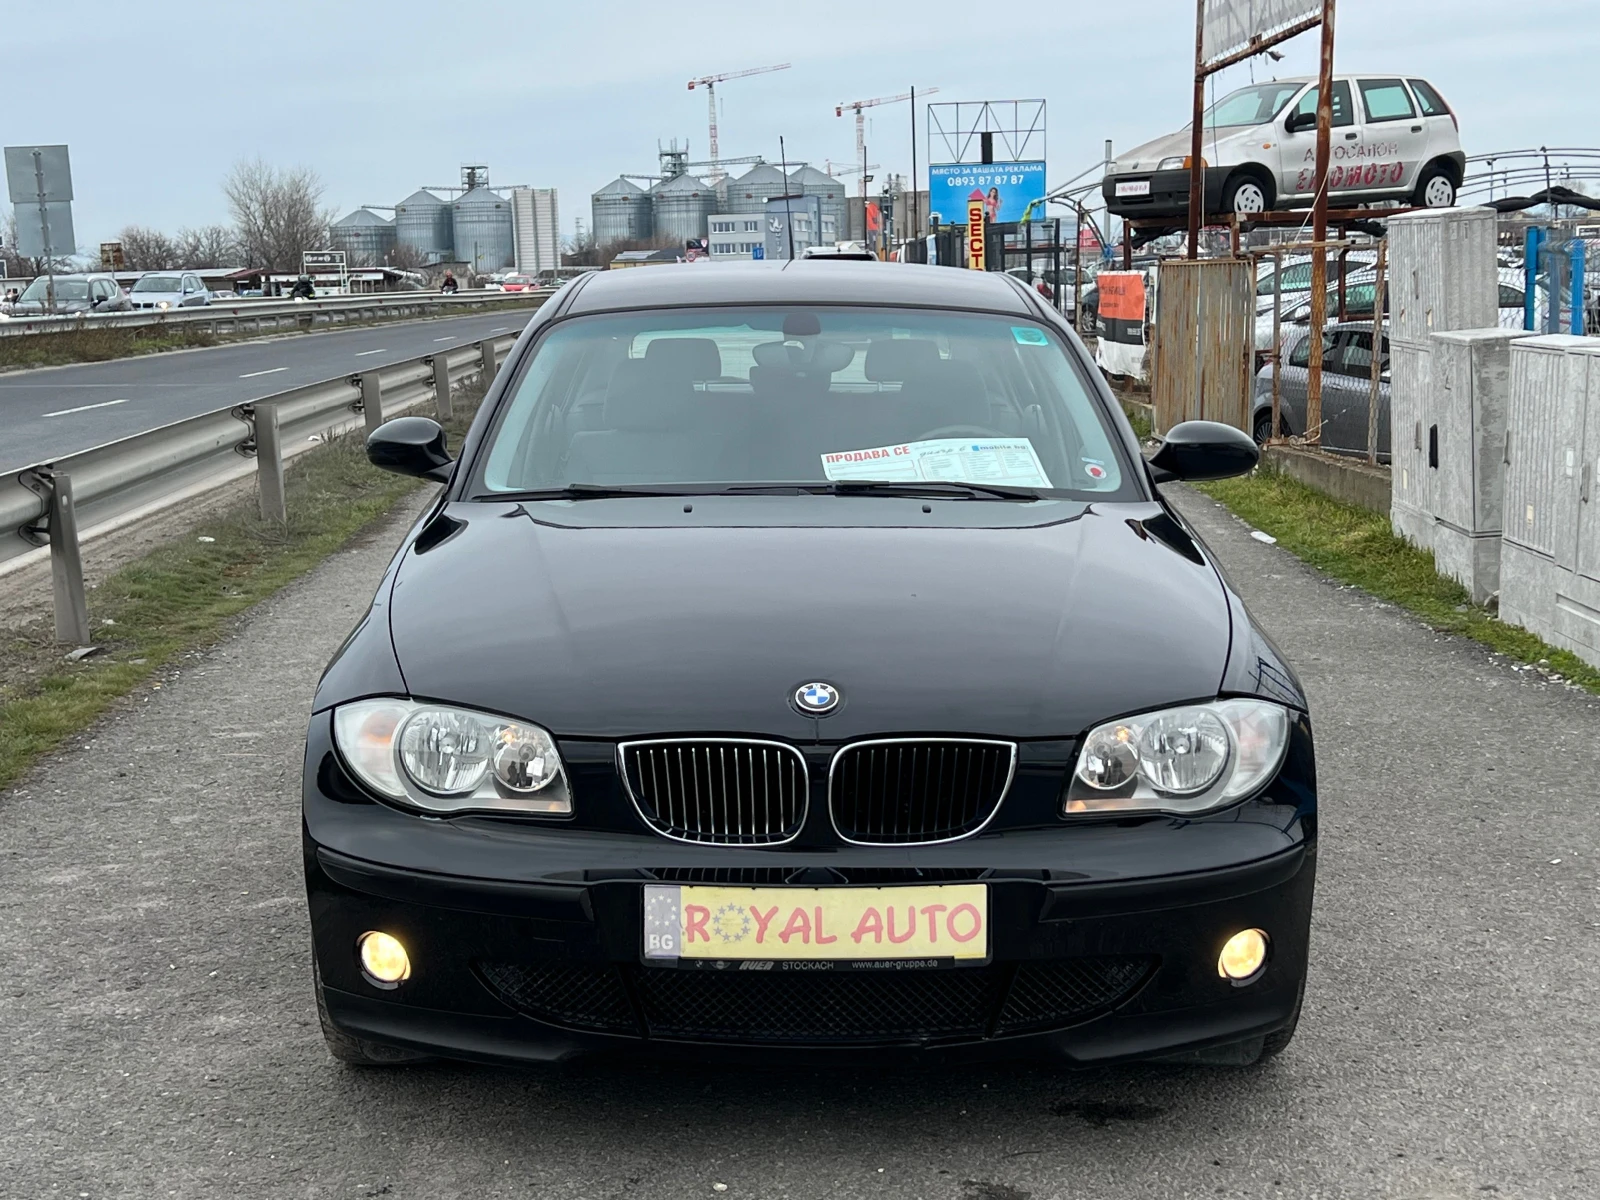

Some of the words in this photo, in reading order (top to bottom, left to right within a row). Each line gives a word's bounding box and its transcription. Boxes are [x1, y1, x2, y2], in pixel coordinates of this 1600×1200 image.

[1303, 143, 1398, 162] АОСАЛОН
[973, 166, 1003, 174] ВАШАТА
[1005, 165, 1042, 173] РЕКЛАМА
[947, 176, 976, 187] 0893
[978, 175, 991, 186] 87
[994, 175, 1008, 185] 87
[1010, 175, 1024, 185] 87
[969, 208, 983, 271] SECT
[825, 448, 890, 463] ПРОДАВА
[893, 445, 911, 456] СЕ
[850, 903, 982, 944] AUTO
[649, 934, 674, 949] BG
[739, 960, 775, 970] AUER
[782, 960, 834, 970] STOCKACH
[852, 959, 938, 969] www.auer-gruppe.de
